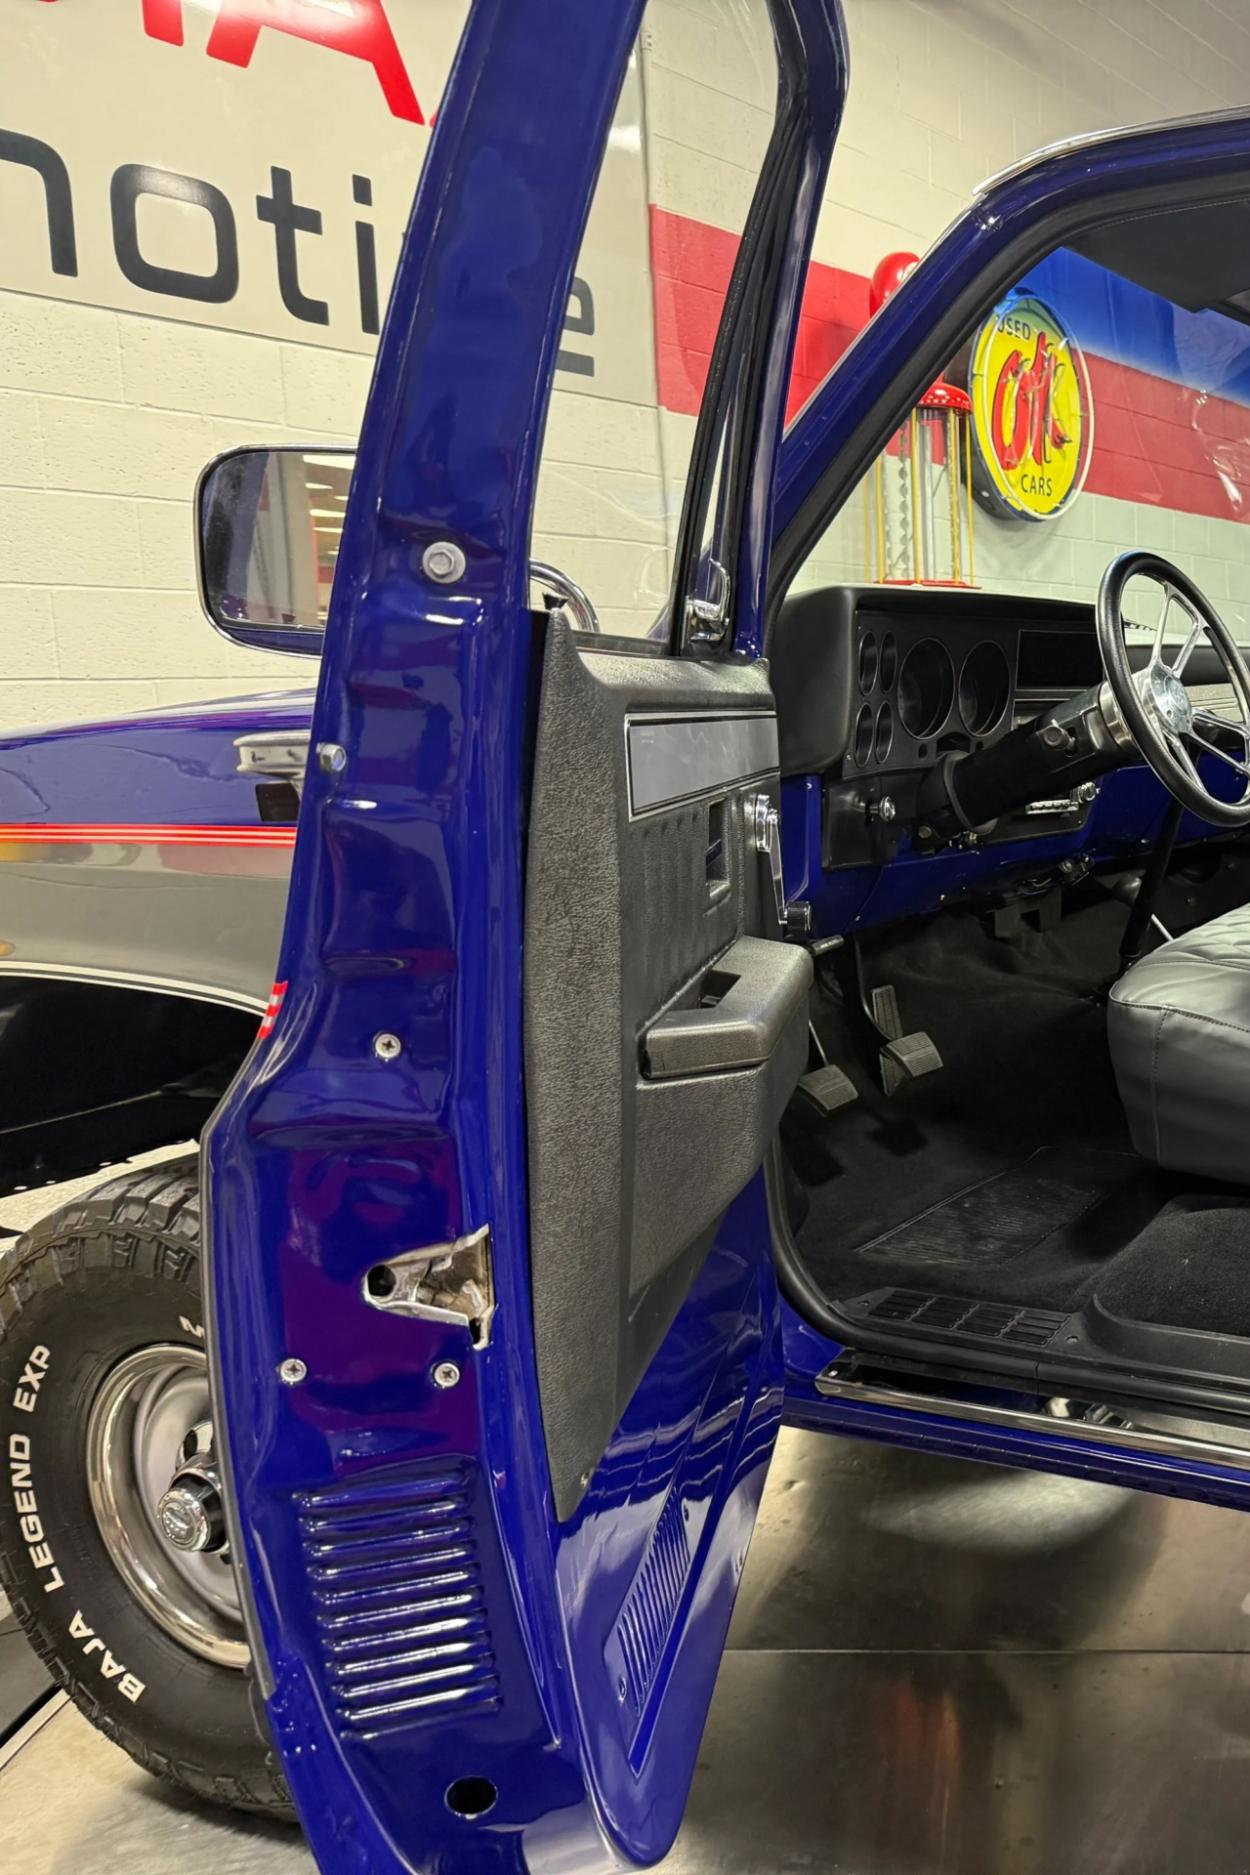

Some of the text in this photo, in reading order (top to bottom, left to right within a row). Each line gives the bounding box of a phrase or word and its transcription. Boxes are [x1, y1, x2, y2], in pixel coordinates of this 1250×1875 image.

[997, 317, 1031, 340] USED
[1020, 473, 1053, 497] CARS
[9, 1344, 146, 1703] BAJA LEGEND EXP
